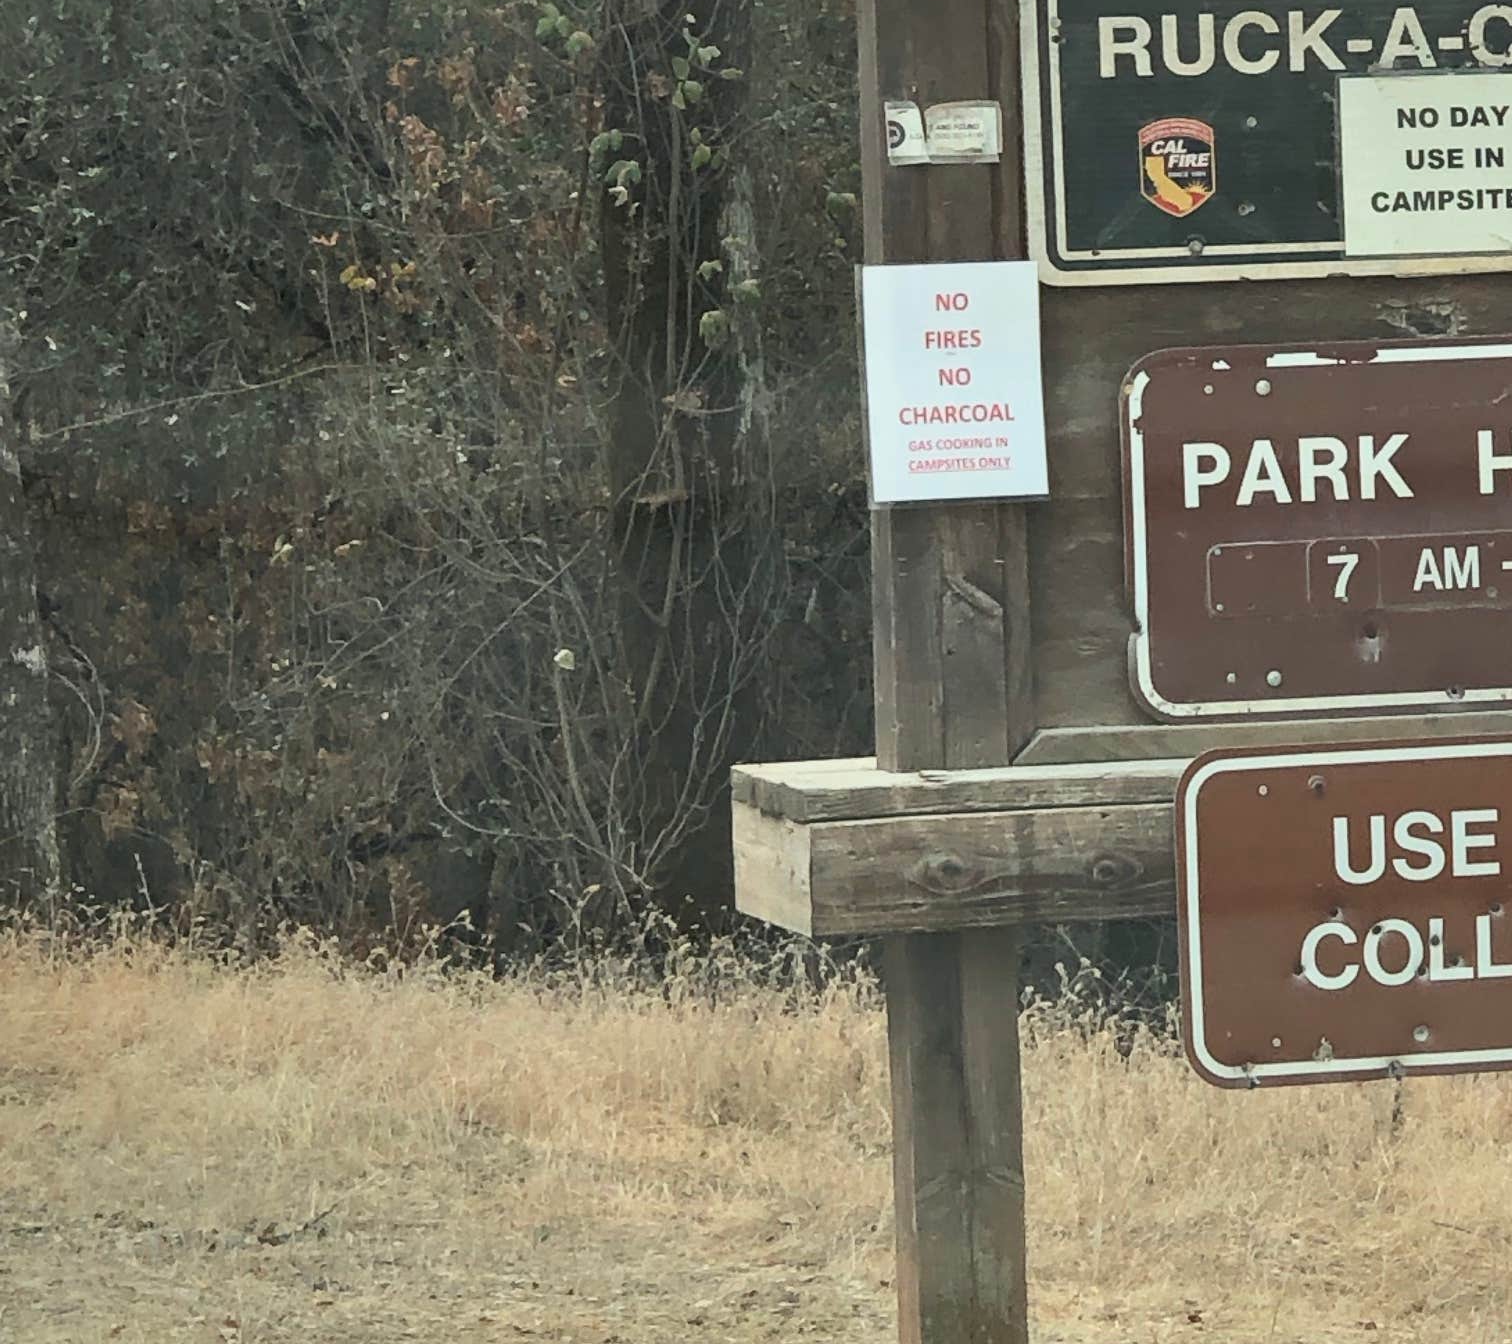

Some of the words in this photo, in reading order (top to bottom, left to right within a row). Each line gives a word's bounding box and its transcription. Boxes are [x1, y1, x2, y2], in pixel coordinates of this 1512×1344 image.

[1396, 107, 1439, 129] NO
[1450, 105, 1510, 127] DAY
[1150, 138, 1188, 155] CAL
[1167, 152, 1211, 168] FIRE
[1405, 148, 1464, 170] USE
[1475, 147, 1505, 168] IN
[934, 293, 969, 312] NO
[924, 329, 983, 350] FIRES
[938, 367, 972, 387] NO
[898, 403, 1016, 426] CHARCOAL
[908, 440, 933, 452] GAS
[935, 437, 993, 451] COOKING
[995, 437, 1009, 448] IN
[907, 457, 977, 471] CAMPSITES
[978, 456, 1011, 469] ONLY
[1182, 433, 1415, 510] PARK
[1327, 553, 1359, 598] 7
[1413, 545, 1480, 592] AM
[1332, 808, 1501, 886] USE
